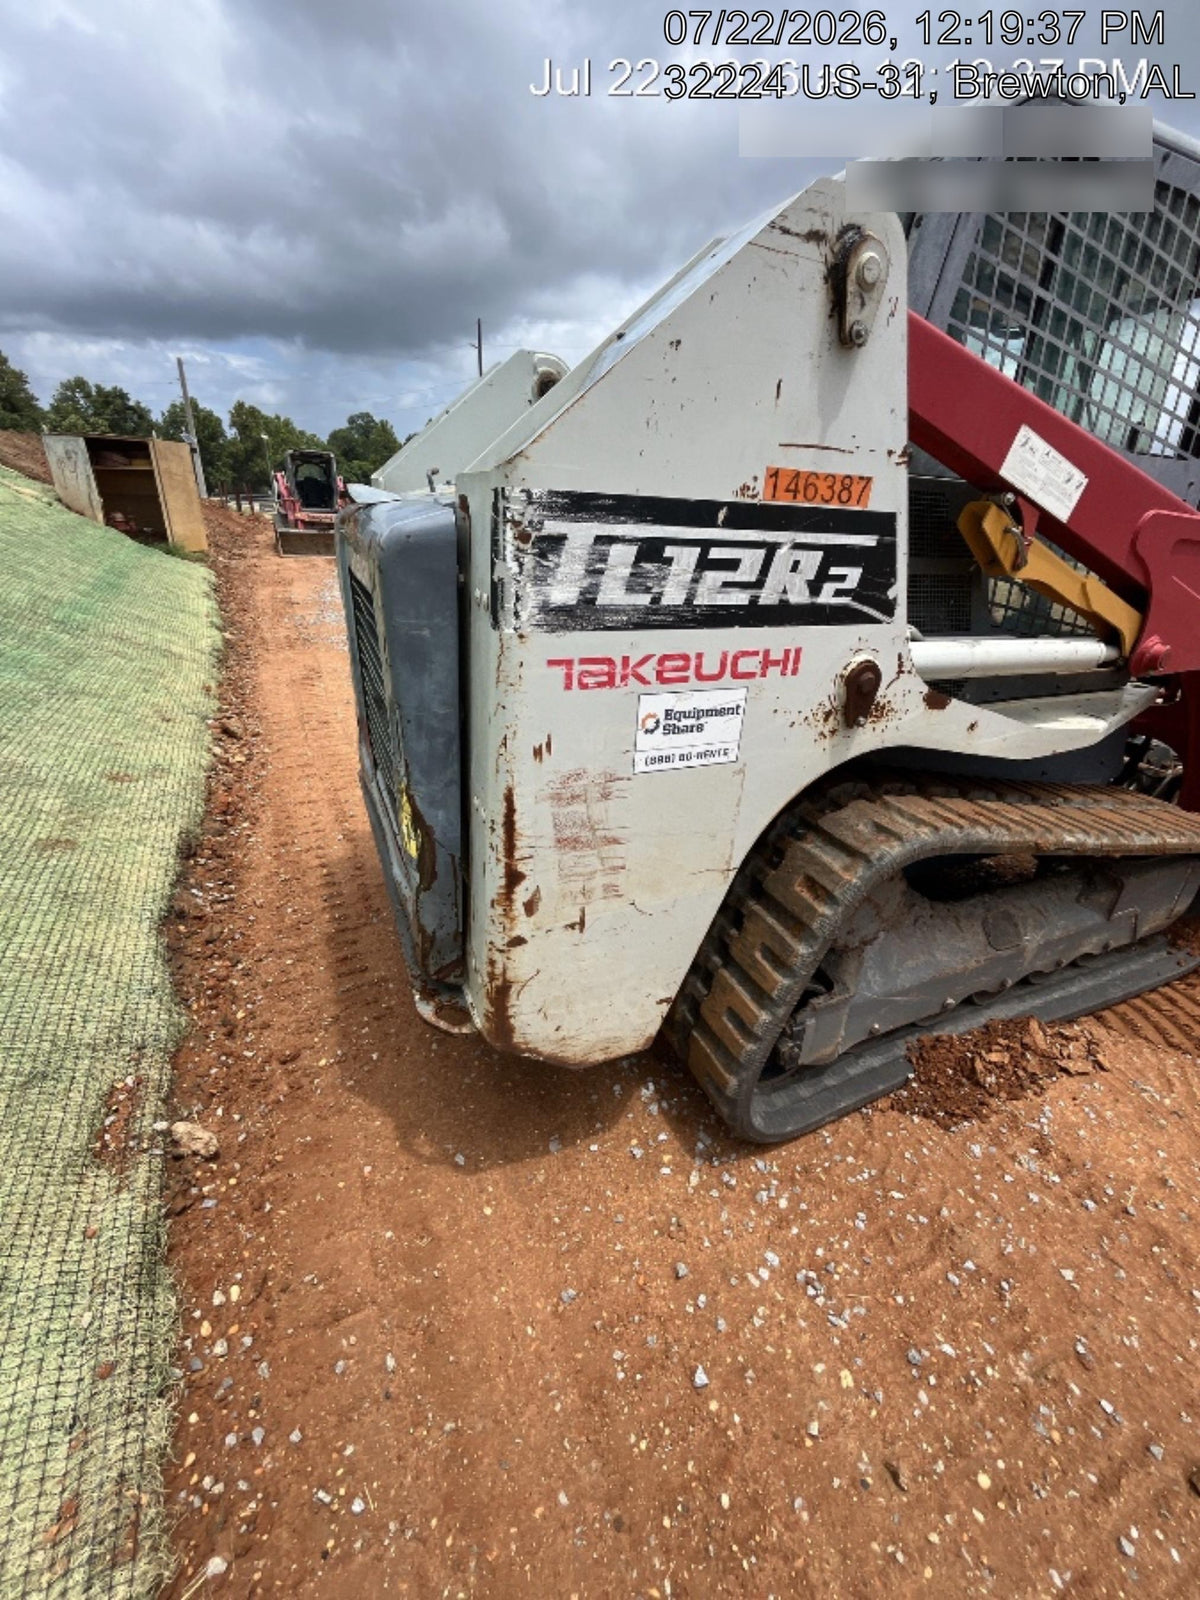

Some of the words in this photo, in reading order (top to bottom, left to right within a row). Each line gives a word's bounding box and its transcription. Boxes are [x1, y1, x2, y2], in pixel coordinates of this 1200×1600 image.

[768, 467, 874, 505] 146387
[664, 703, 742, 722] Equipment
[662, 722, 705, 736] Share
